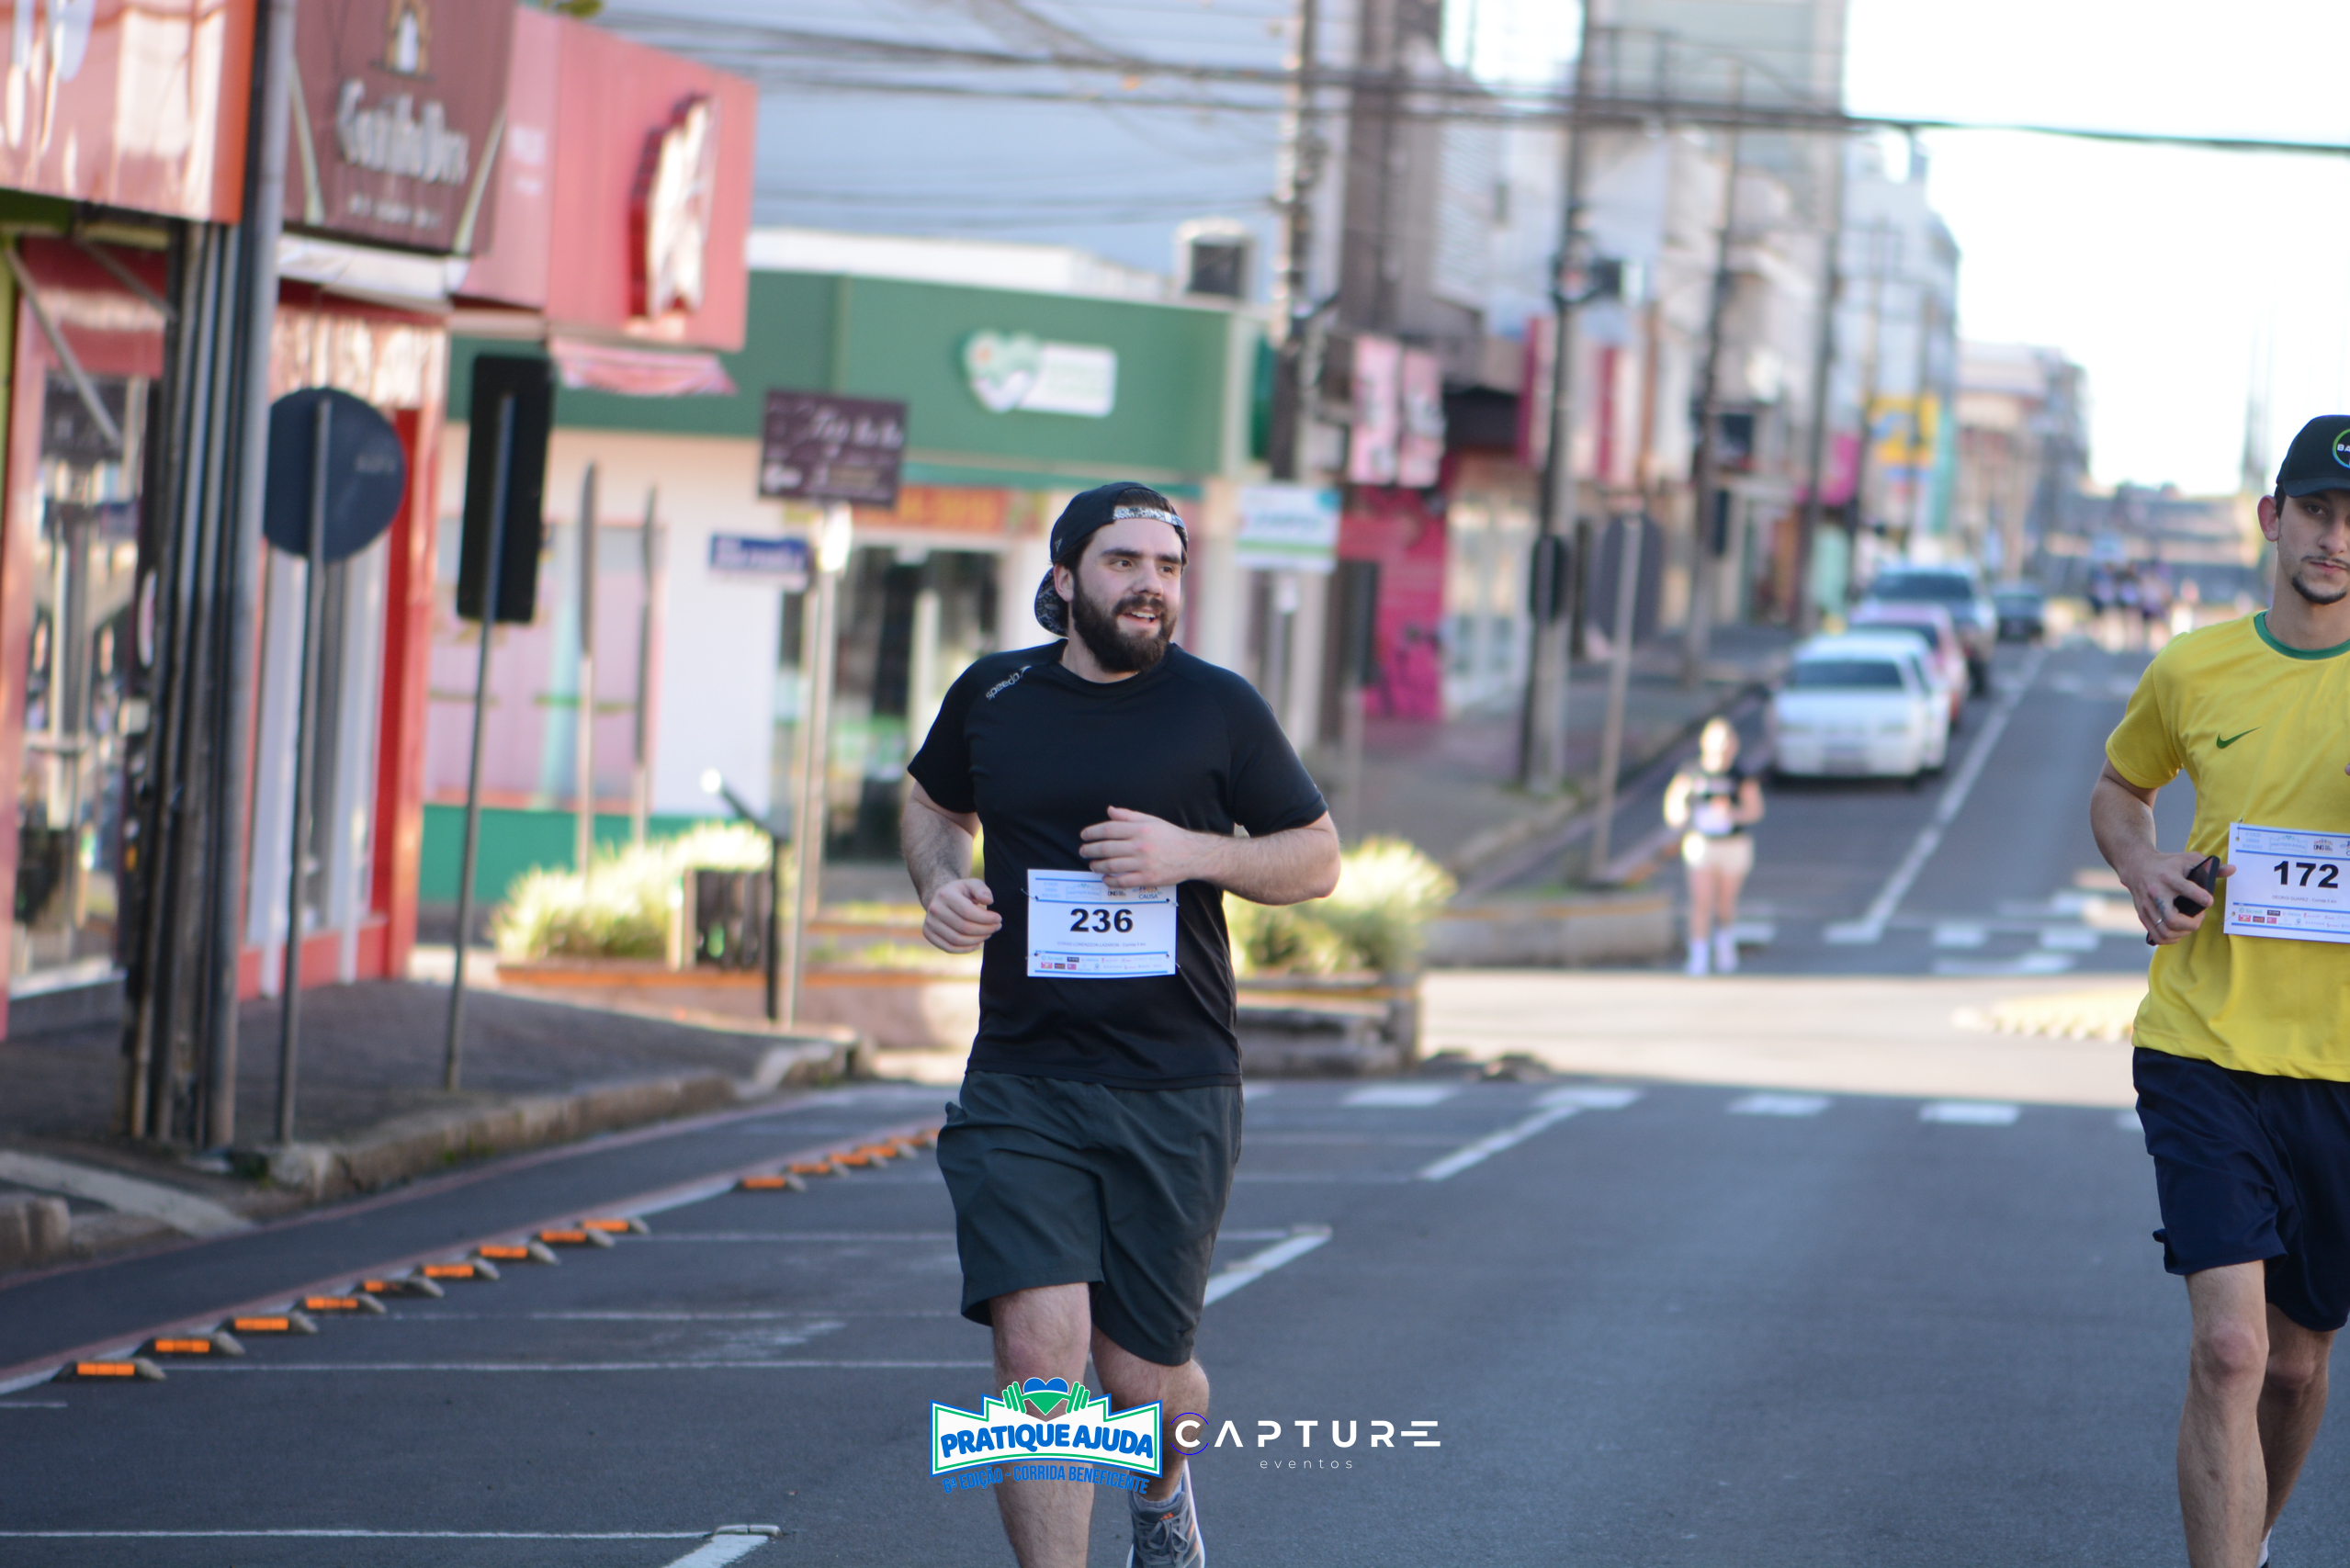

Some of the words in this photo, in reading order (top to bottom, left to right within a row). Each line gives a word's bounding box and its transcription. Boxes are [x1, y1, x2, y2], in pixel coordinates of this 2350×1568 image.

[986, 672, 1020, 701] speedo
[2274, 860, 2339, 889] 172
[1069, 908, 1134, 933] 236
